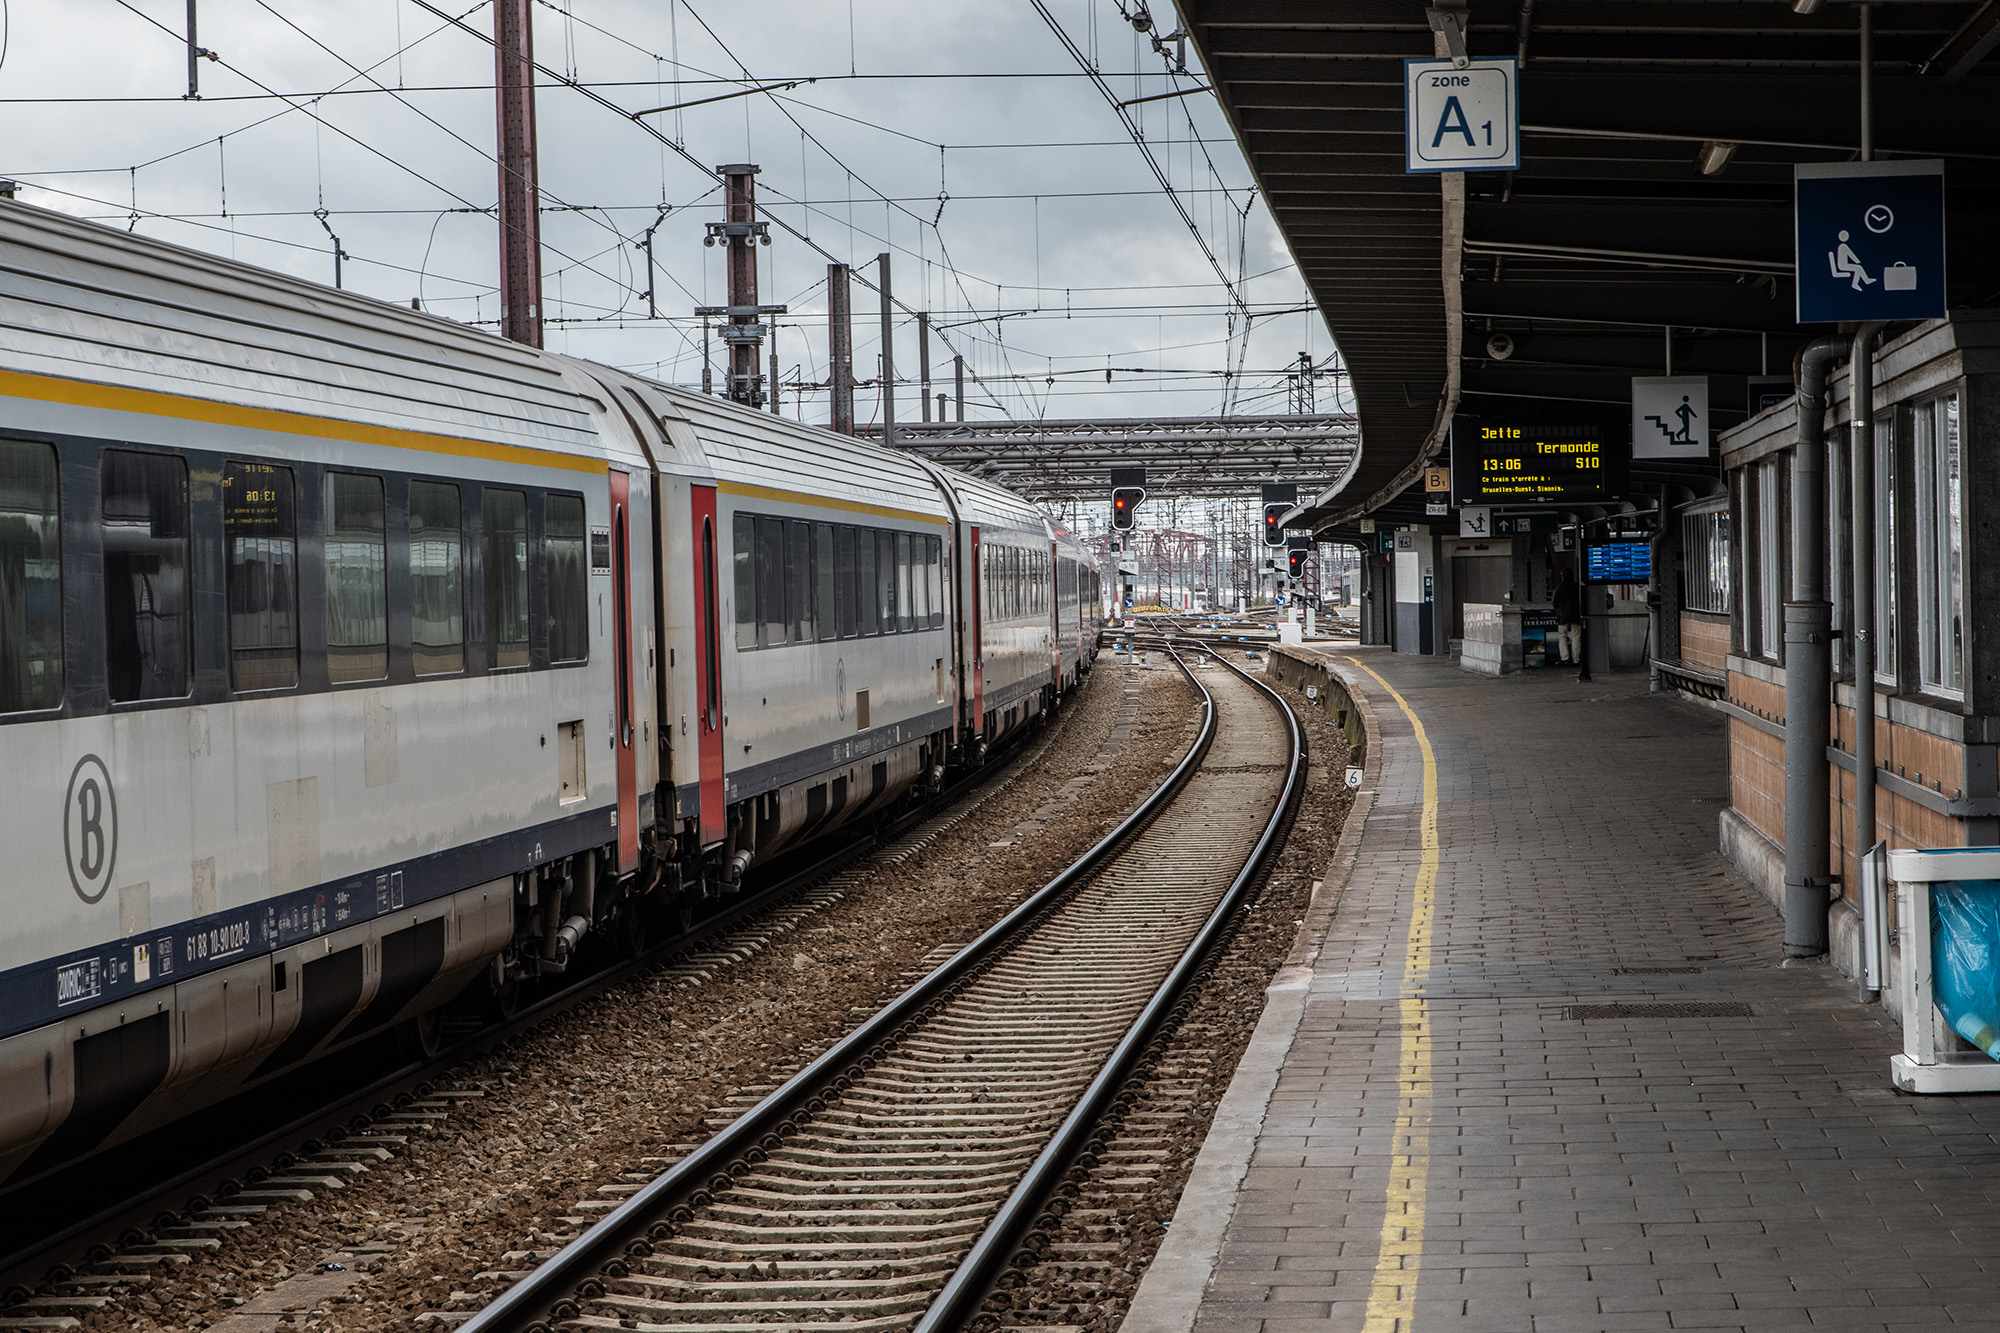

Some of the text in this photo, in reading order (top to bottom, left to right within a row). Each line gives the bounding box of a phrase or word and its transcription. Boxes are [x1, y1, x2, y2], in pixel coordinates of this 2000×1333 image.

[1431, 75, 1470, 87] zone
[1481, 427, 1521, 439] Jette
[1536, 441, 1599, 454] Termonde
[1483, 457, 1599, 471] 13:06 S10
[1349, 771, 1357, 784] 6
[186, 936, 196, 962] 61
[197, 932, 207, 959] 88
[229, 919, 250, 949] 020-8
